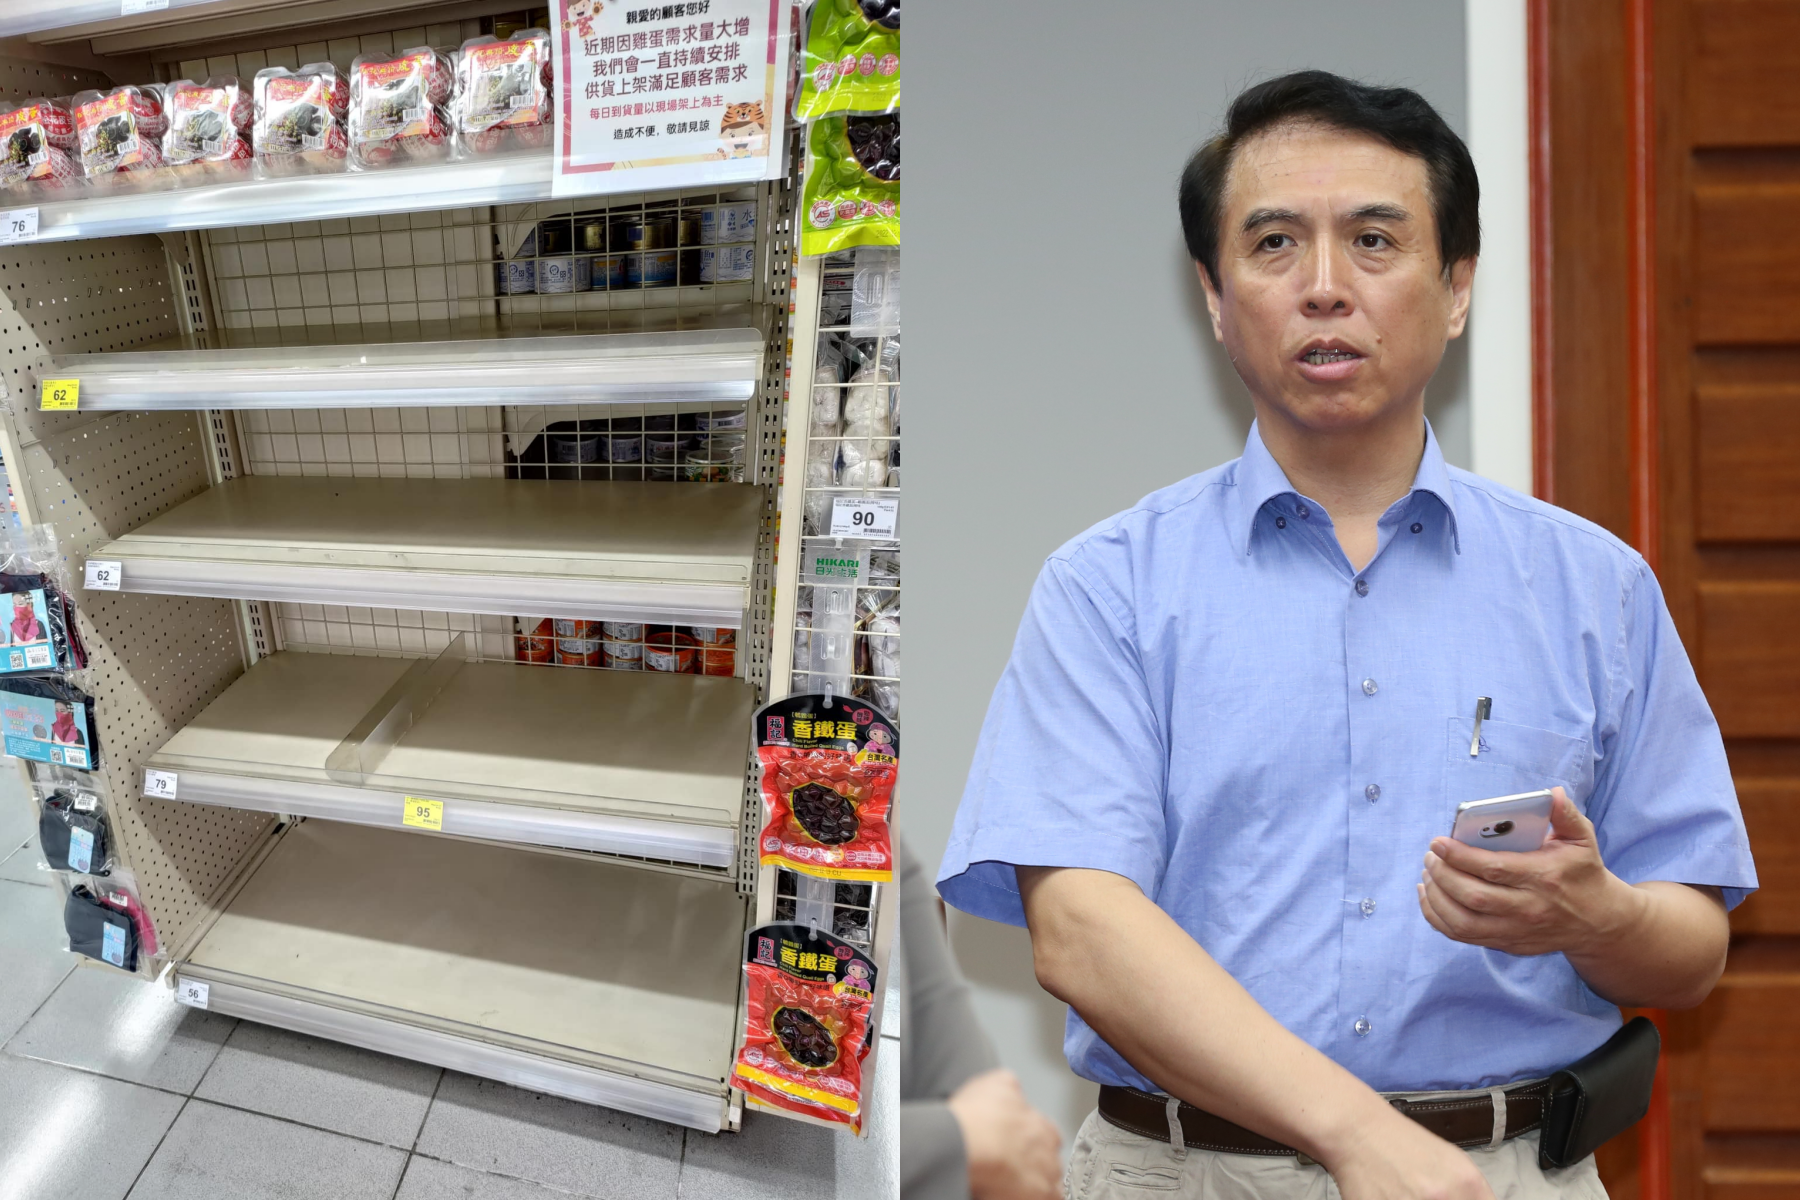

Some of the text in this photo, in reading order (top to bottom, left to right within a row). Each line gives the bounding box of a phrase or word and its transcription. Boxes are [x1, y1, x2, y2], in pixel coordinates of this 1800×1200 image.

[626, 1, 710, 24] 親愛的顧客您好
[584, 17, 750, 57] 近期因雞蛋需求量大增
[592, 41, 741, 78] 我們會一直持續安排
[584, 64, 748, 100] 供貨上架滿足顧客需求
[589, 95, 724, 120] 每日到貨量以現場架上為主
[11, 220, 26, 234] 76
[53, 389, 67, 401] 62
[852, 511, 875, 527] 90
[816, 558, 859, 568] HIKARI
[97, 570, 110, 582] 62
[769, 718, 783, 739] 福記
[792, 720, 858, 741] 香鐵蛋
[155, 779, 167, 790] 79
[416, 806, 431, 818] 95
[759, 939, 772, 960] 福記
[780, 946, 838, 973] 香鐵蛋
[188, 988, 199, 999] 56
